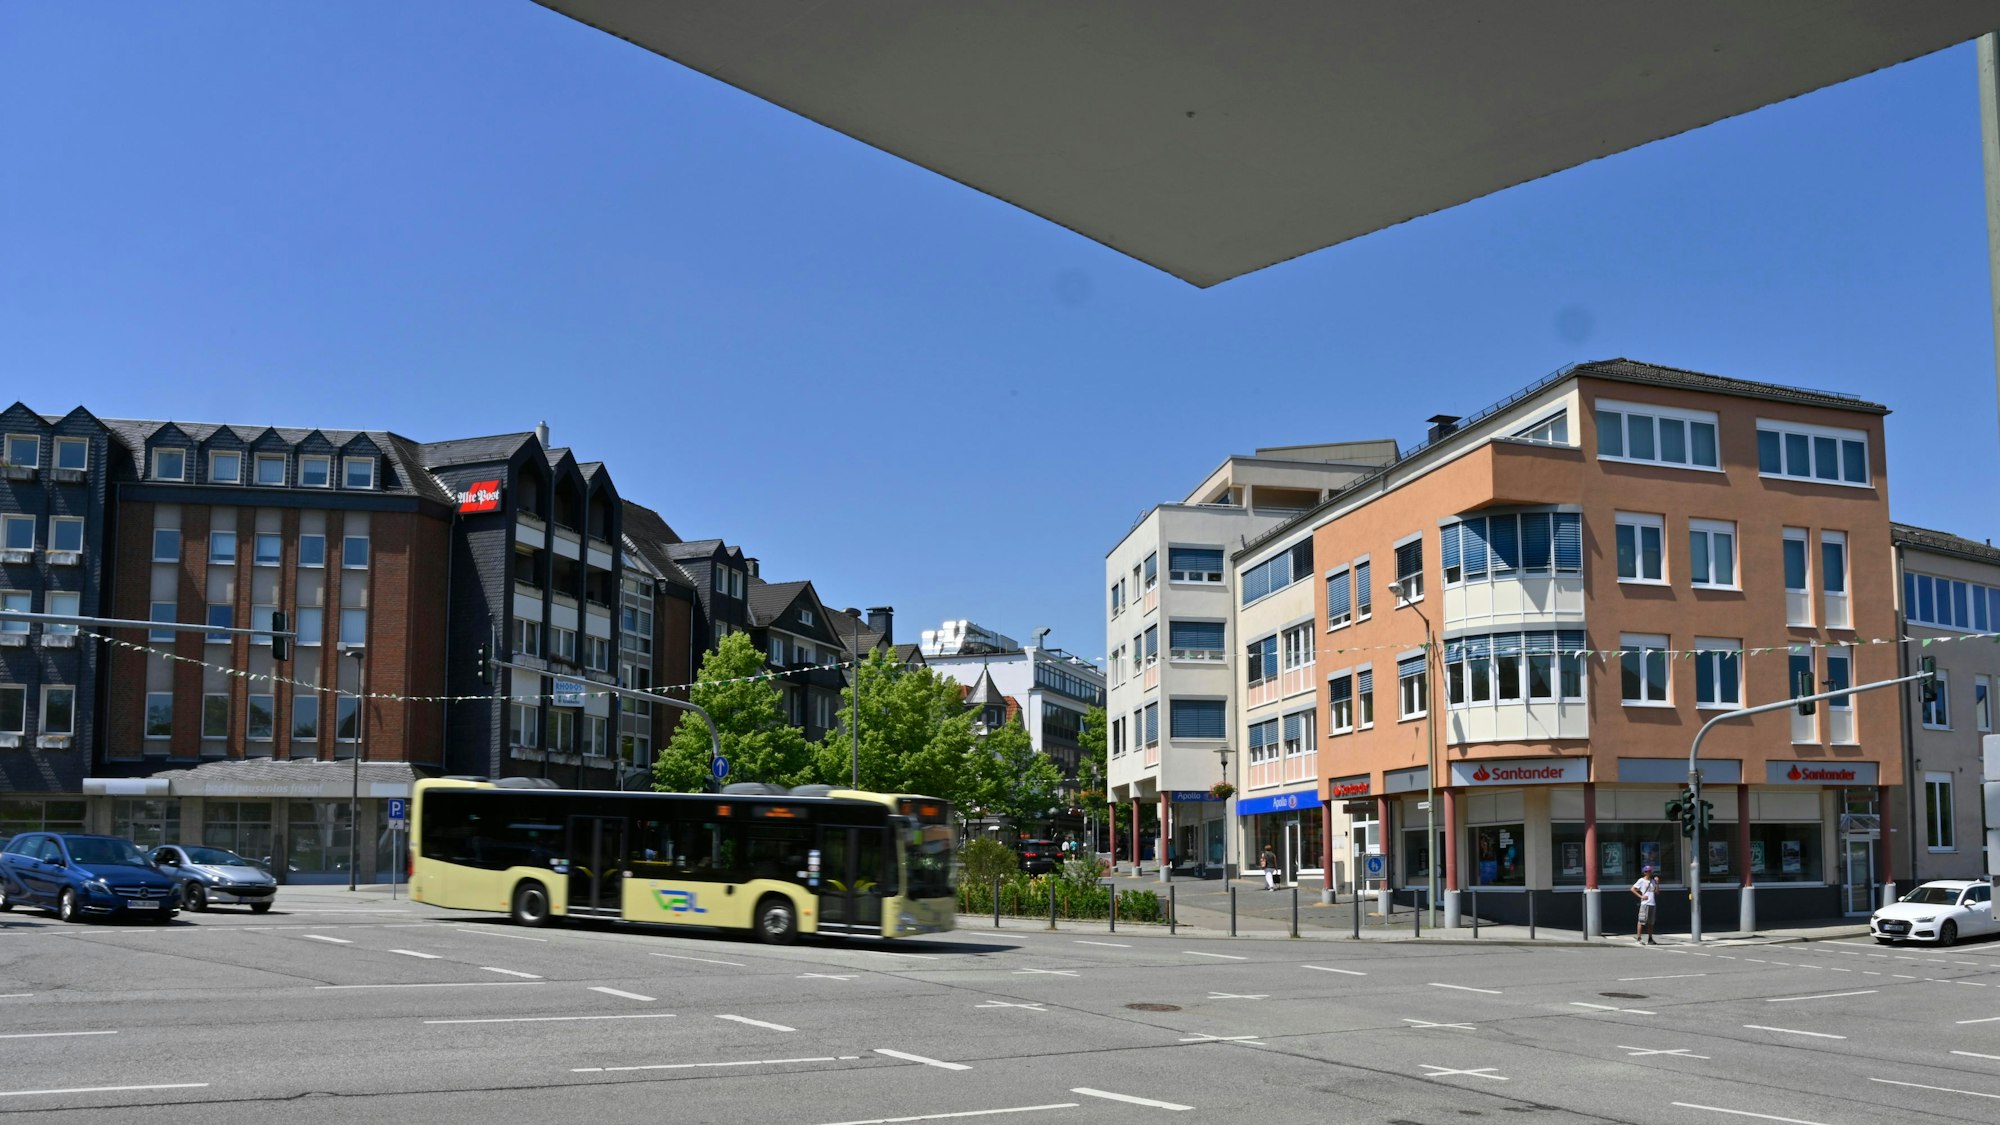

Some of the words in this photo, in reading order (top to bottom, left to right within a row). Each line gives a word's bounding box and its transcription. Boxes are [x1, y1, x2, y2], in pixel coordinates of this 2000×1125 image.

[457, 491, 477, 504] Alte
[477, 490, 500, 505] Post
[1492, 766, 1565, 781] Santander
[1802, 768, 1856, 781] Santander
[236, 784, 288, 796] pausenlos
[1178, 791, 1201, 800] Apollo
[391, 801, 401, 817] P
[1273, 796, 1288, 810] Apollo
